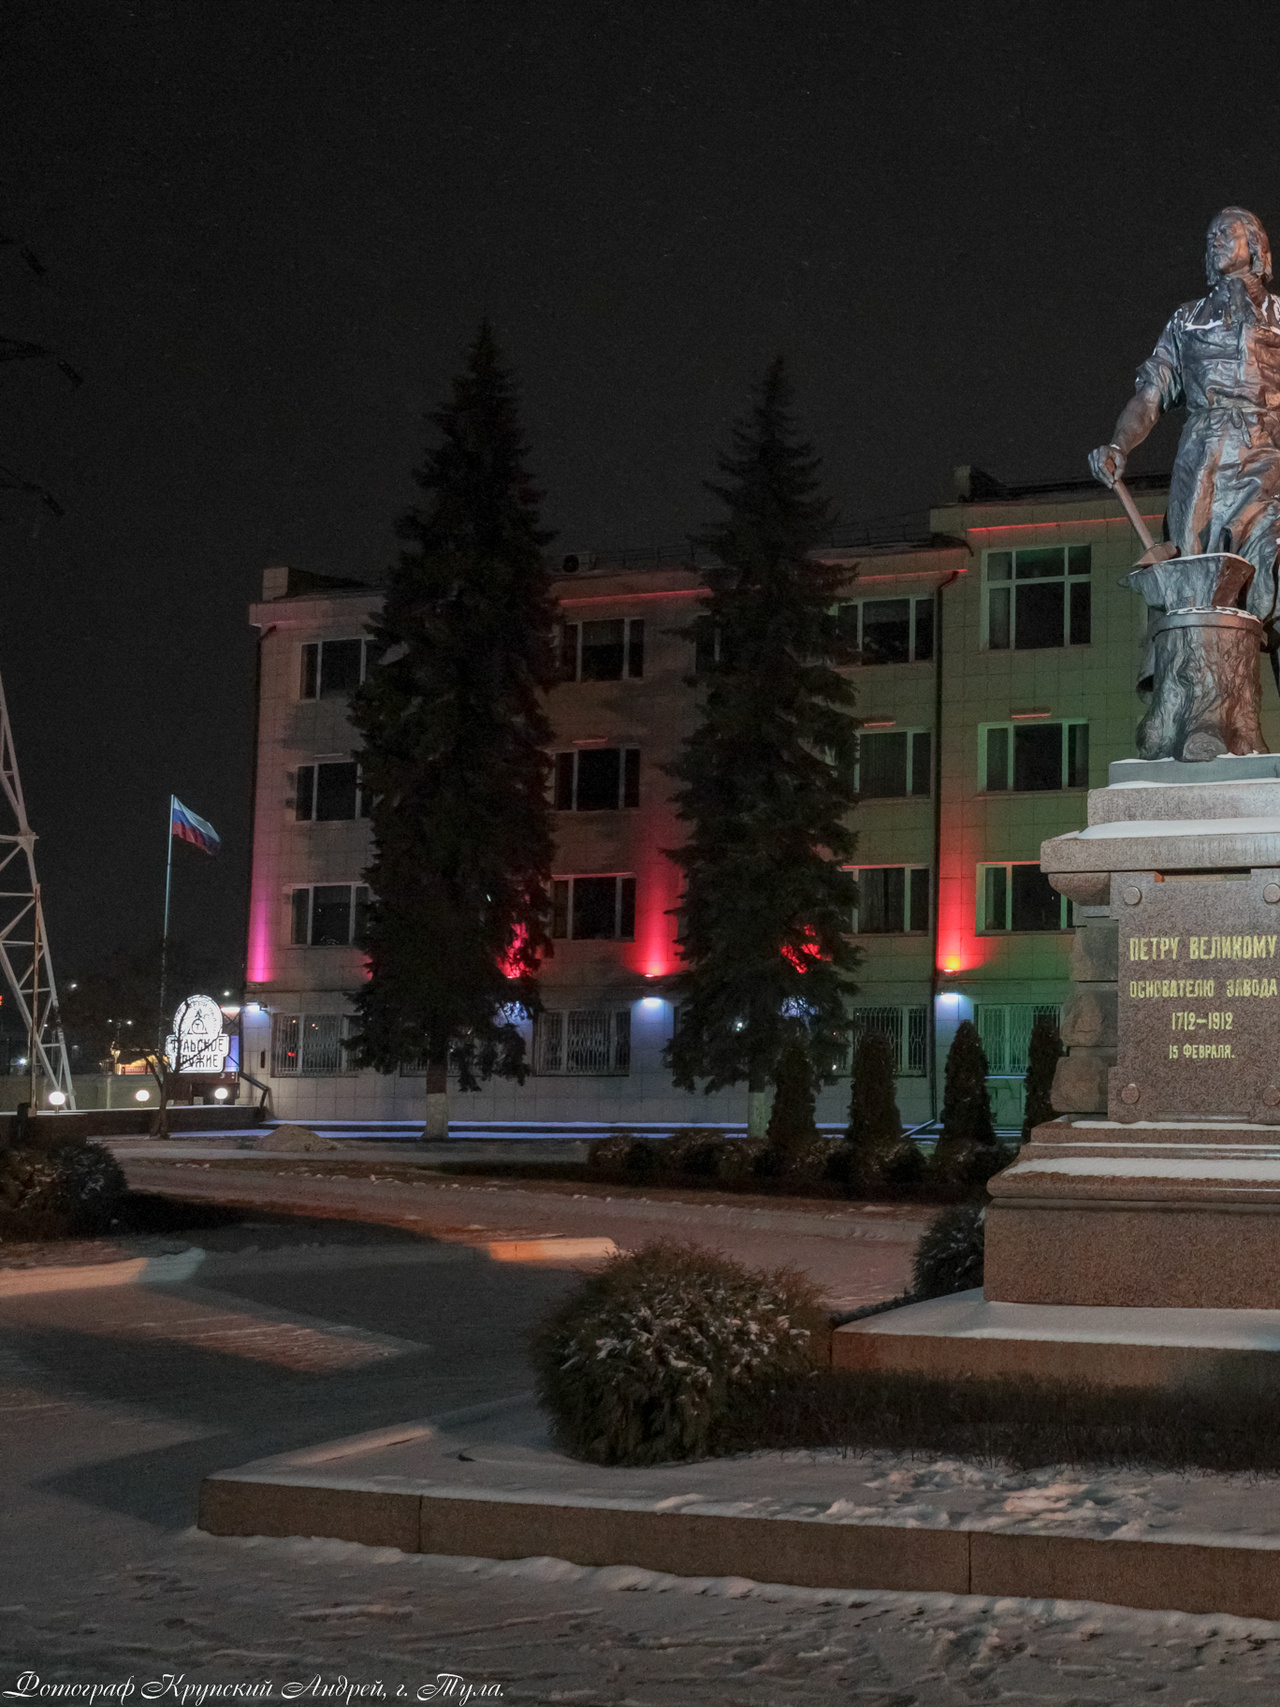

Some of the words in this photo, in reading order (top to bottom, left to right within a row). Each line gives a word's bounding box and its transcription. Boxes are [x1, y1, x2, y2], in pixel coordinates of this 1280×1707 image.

[1129, 936, 1180, 961] ПЕТРУ
[1189, 934, 1278, 960] ВЕЛИКОМУ
[1129, 979, 1215, 998] ОСНОВАТЕЛЮ
[1225, 977, 1278, 998] ЗАВОДА
[170, 1038, 224, 1053] ТЛЬСКОЕ
[1168, 1044, 1179, 1059] 15
[1182, 1043, 1236, 1059] ФЕВРАЛЯ.
[176, 1054, 219, 1068] РУЖИЕ
